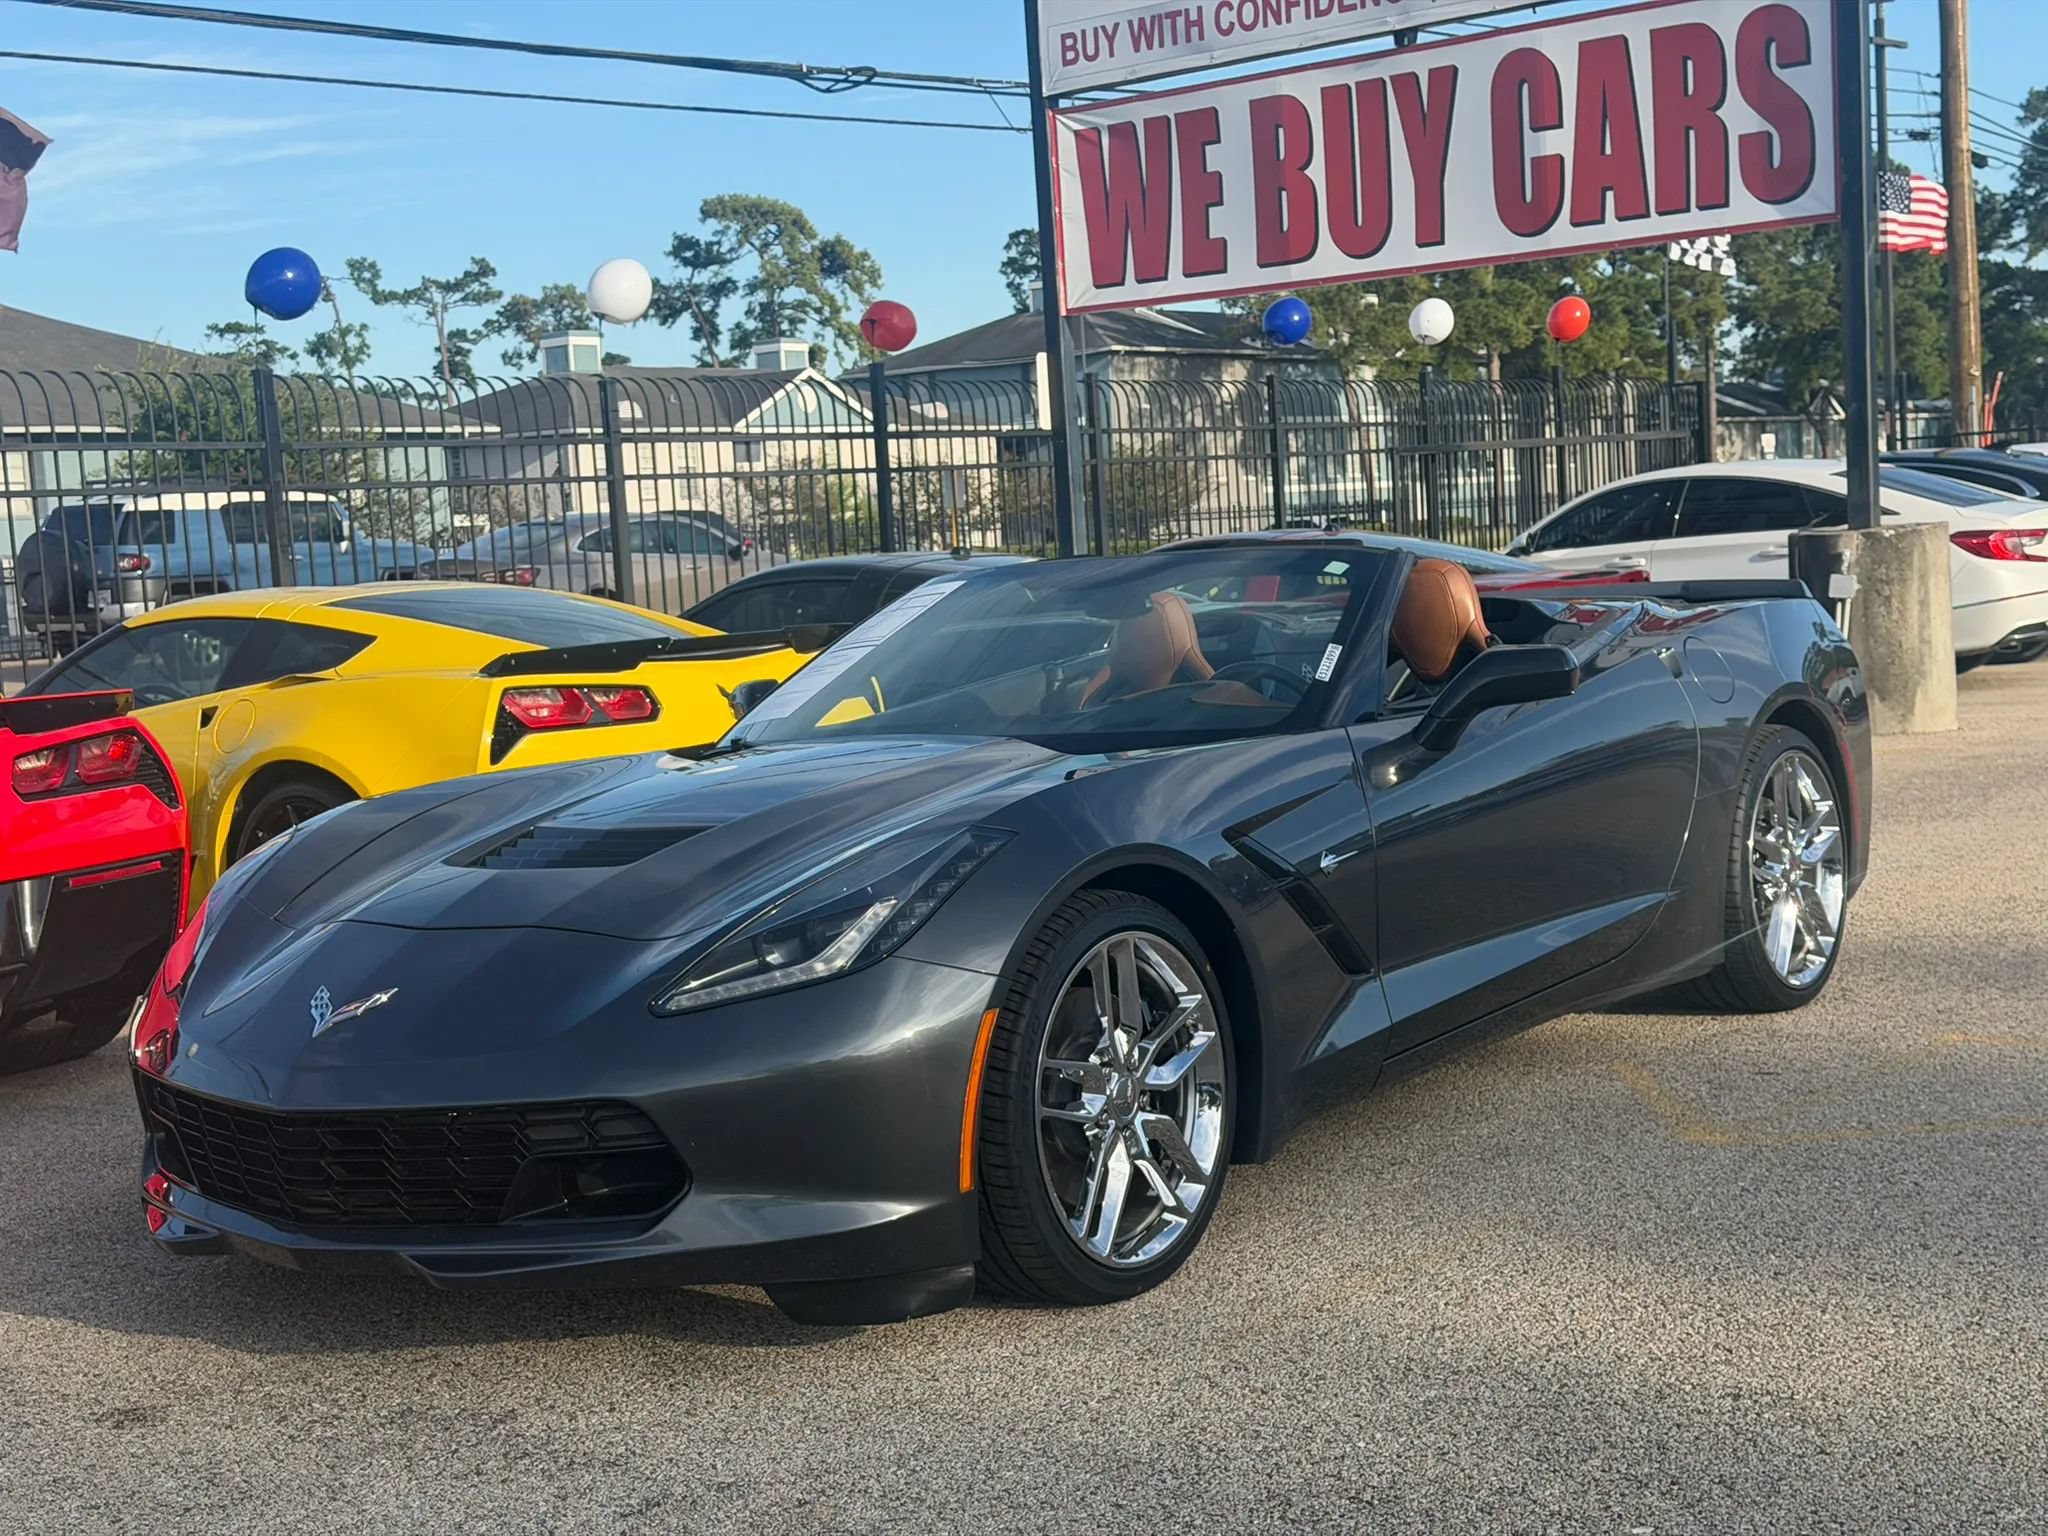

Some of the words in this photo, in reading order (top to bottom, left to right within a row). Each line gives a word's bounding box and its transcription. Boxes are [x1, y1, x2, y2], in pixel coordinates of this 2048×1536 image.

[1060, 22, 1120, 67] BUY
[1127, 5, 1205, 53] WITH
[1073, 106, 1229, 290] WE
[1249, 65, 1459, 269] BUY
[1490, 3, 1816, 237] CARS
